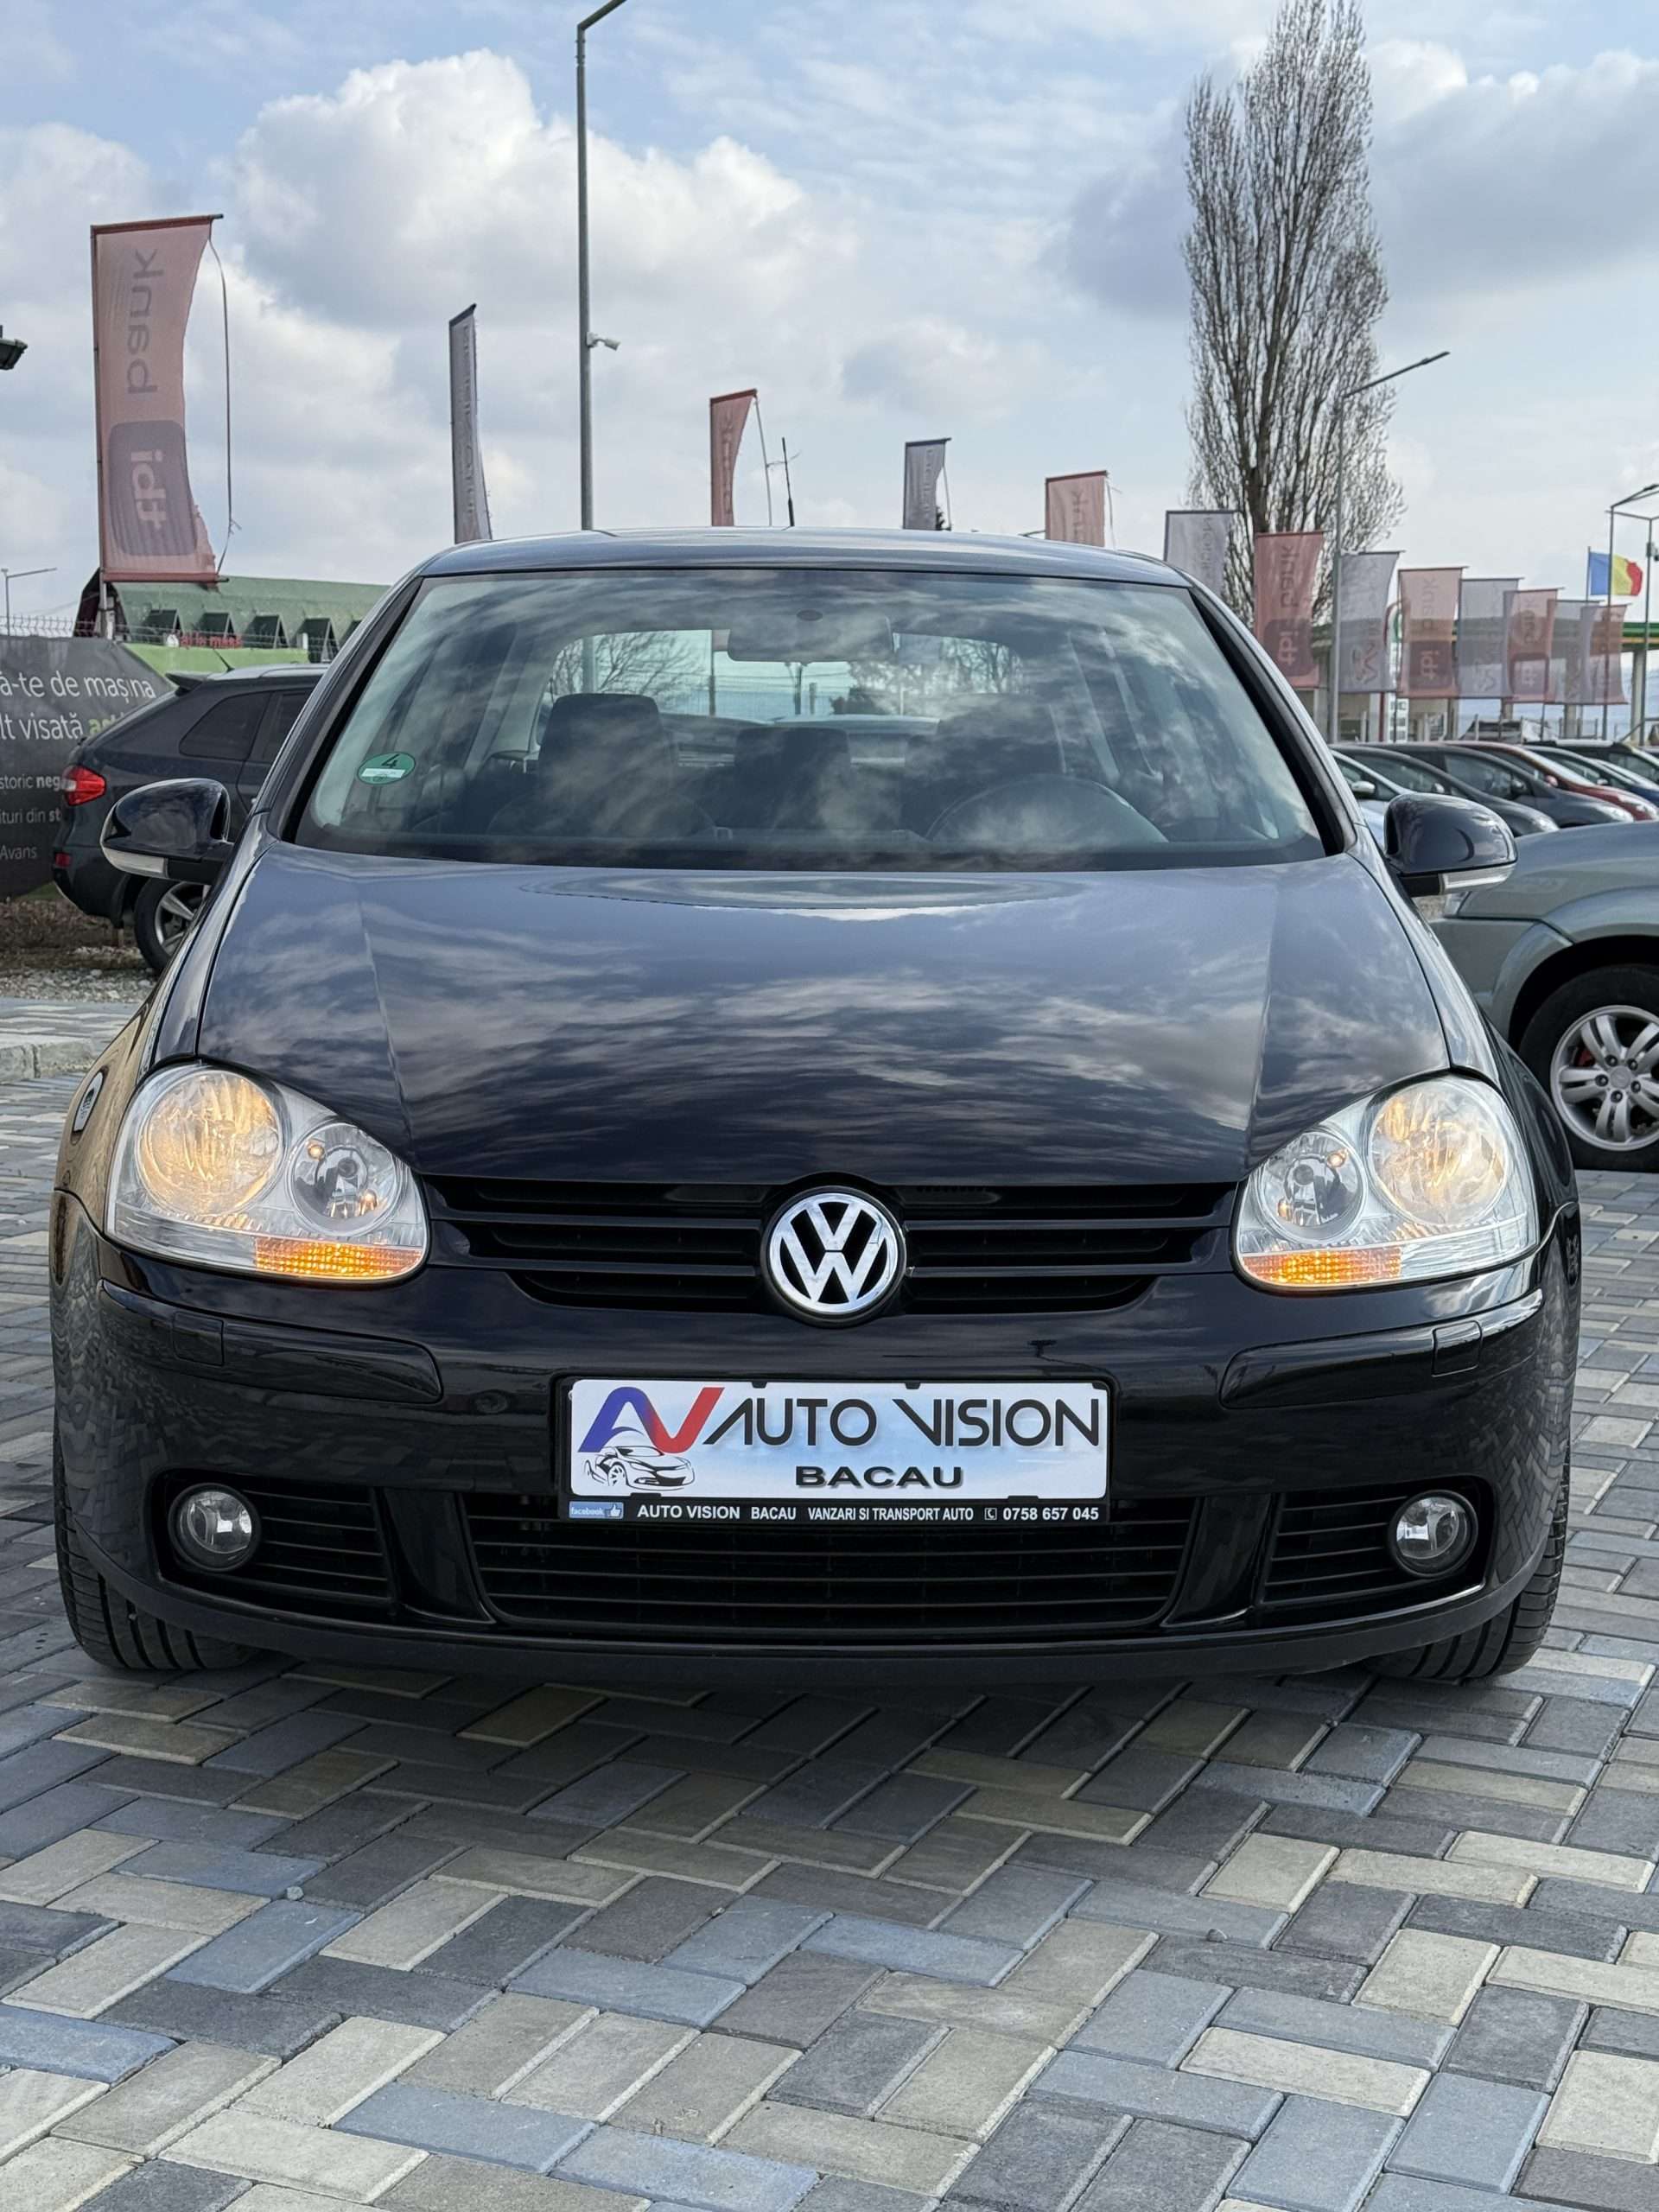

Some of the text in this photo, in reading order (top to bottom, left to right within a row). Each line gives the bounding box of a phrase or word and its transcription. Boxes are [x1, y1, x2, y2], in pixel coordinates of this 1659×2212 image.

[50, 670, 80, 697] de
[84, 676, 156, 704] mașina
[19, 712, 84, 741] visată
[381, 753, 400, 769] 4
[26, 807, 47, 823] din
[702, 1397, 877, 1446] AUTO
[892, 1398, 1099, 1447] VISION
[796, 1465, 964, 1488] BACAU
[637, 1504, 1099, 1521] AUTO VISION BACAU VANZARI SI TRANSPORT AUTO 0758 657 045
